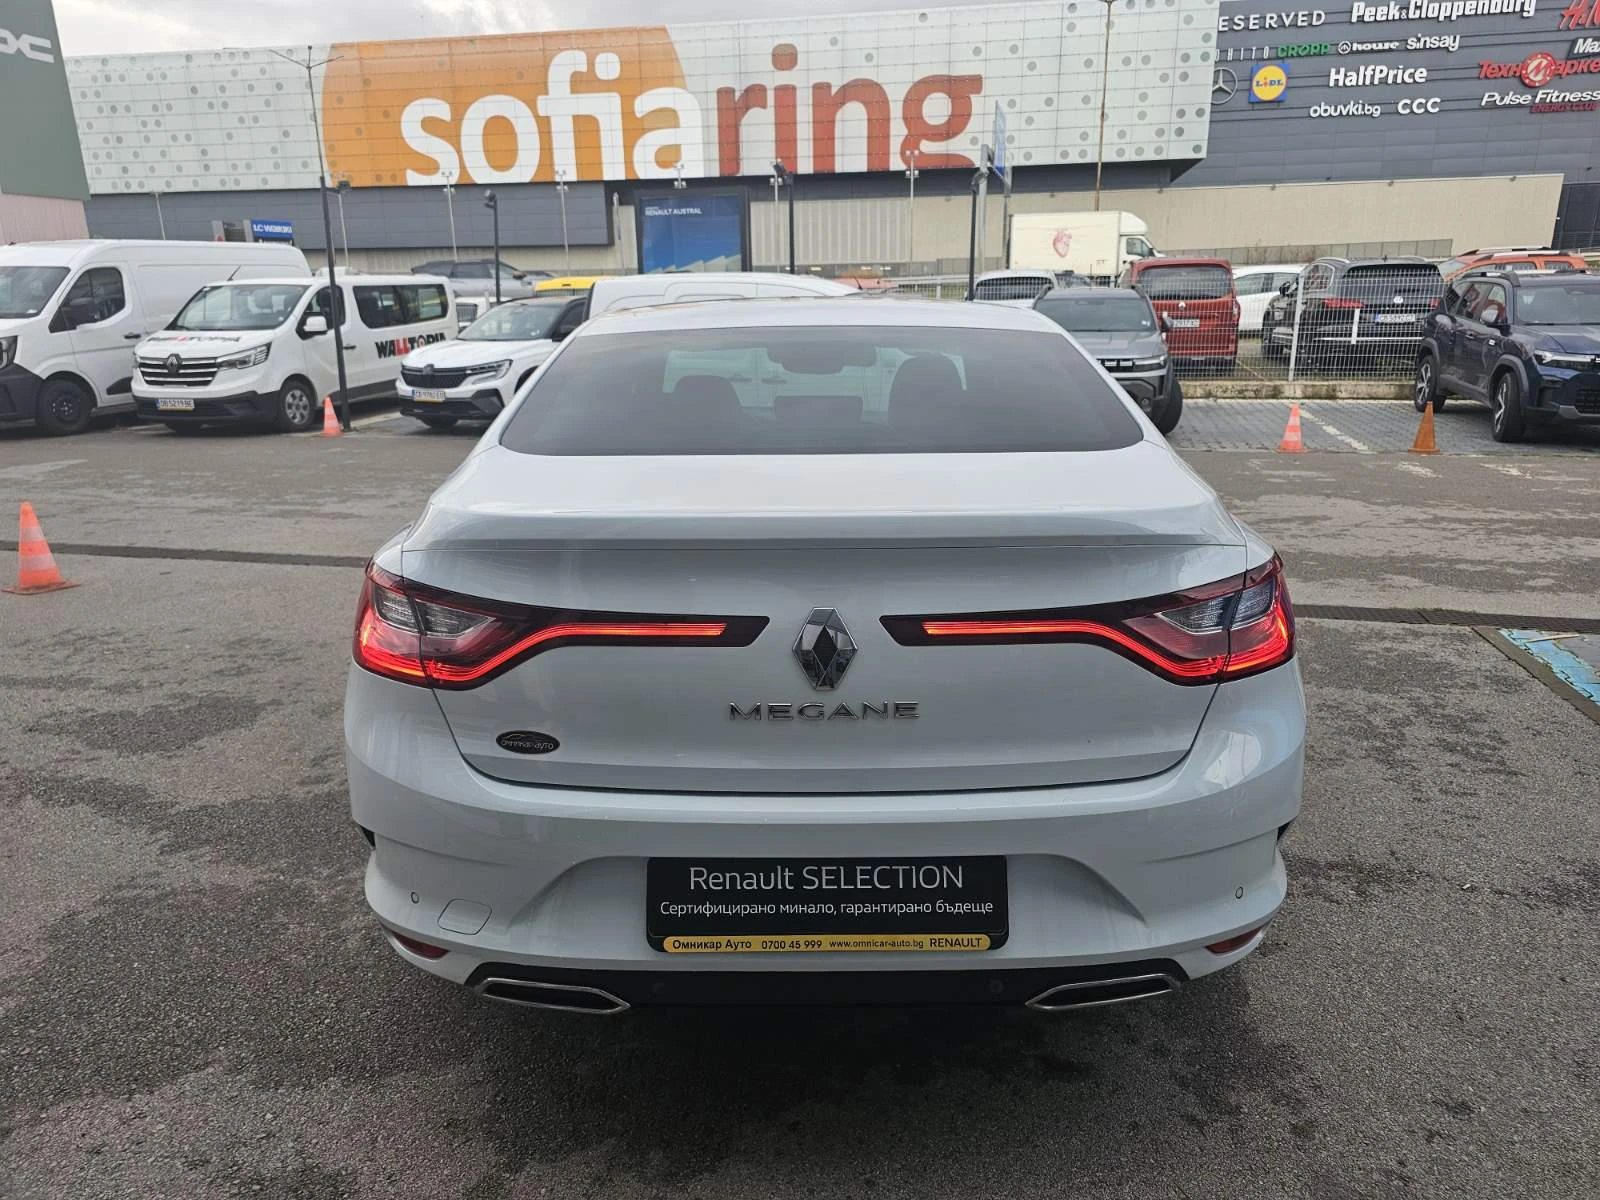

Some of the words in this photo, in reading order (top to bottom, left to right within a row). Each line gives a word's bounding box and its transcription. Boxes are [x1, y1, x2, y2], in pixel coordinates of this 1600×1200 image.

[1406, 33, 1460, 51] sinsay
[1329, 65, 1428, 87] HalfPrice
[1397, 97, 1441, 114] CCC
[1481, 91, 1532, 106] Pulse
[1535, 88, 1600, 104] Fitness
[1309, 101, 1381, 118] obuvki.bg
[729, 701, 920, 721] MEGANE
[690, 865, 794, 890] Renault
[802, 865, 963, 890] SELECTION
[660, 901, 776, 917] Сертифицирано
[780, 903, 837, 916] минало,
[840, 903, 932, 916] гарантирано
[936, 900, 993, 915] бъдеще
[672, 940, 722, 950] Омникар
[725, 939, 752, 951] Ауто
[761, 940, 786, 950] 0700
[788, 940, 801, 950] 45
[804, 940, 822, 950] 999
[829, 938, 924, 949] www.omnicar-auto.bg
[929, 937, 982, 948] RENAULT
